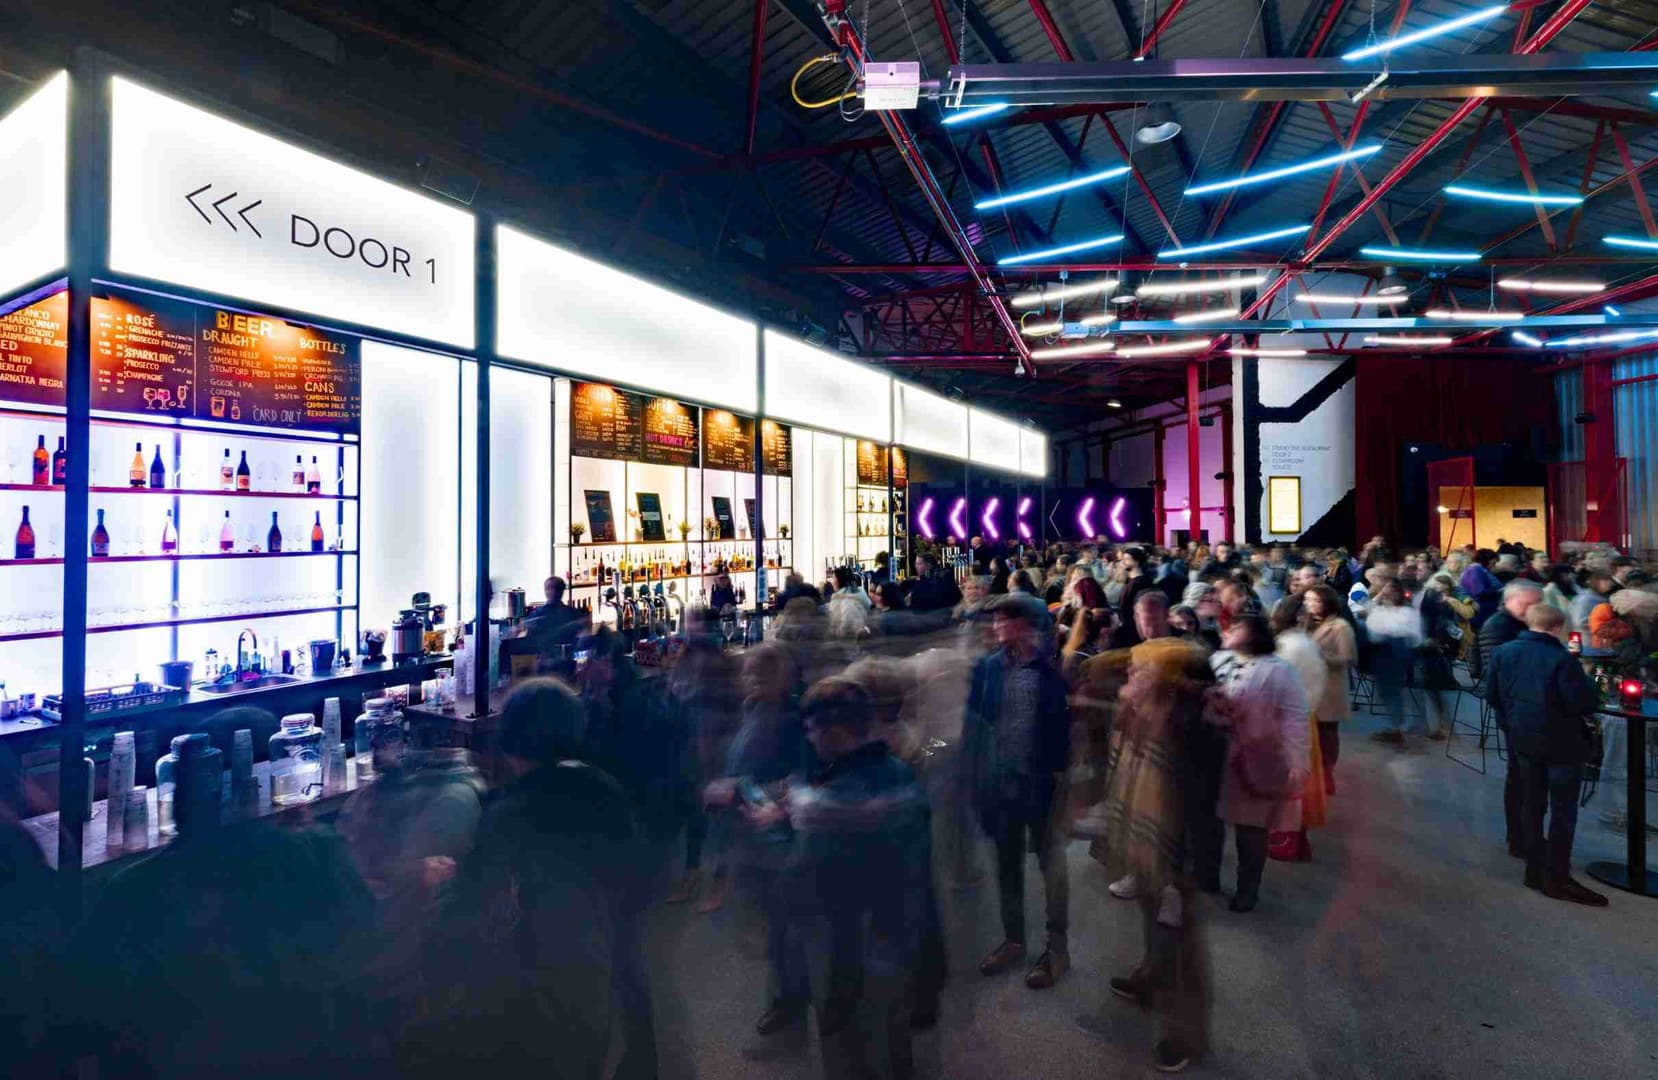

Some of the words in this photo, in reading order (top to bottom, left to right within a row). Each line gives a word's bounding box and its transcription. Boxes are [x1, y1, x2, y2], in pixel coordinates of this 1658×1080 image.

[291, 213, 411, 277] DOOR
[425, 258, 435, 285] 1
[126, 311, 156, 327] ROSÉ
[216, 310, 273, 338] BEER
[0, 339, 18, 351] ED
[128, 334, 159, 345] PROSECCO
[203, 328, 257, 348] DRAUGHT
[300, 336, 347, 355] BOTTLES
[8, 354, 33, 365] TINTO
[126, 347, 175, 364] SPARKLING
[125, 358, 160, 370] PROSECCO
[0, 373, 36, 385] ARNATXA
[39, 377, 64, 389] NEGRA
[126, 370, 164, 382] CHAMPAGNE
[304, 381, 335, 394] CANS
